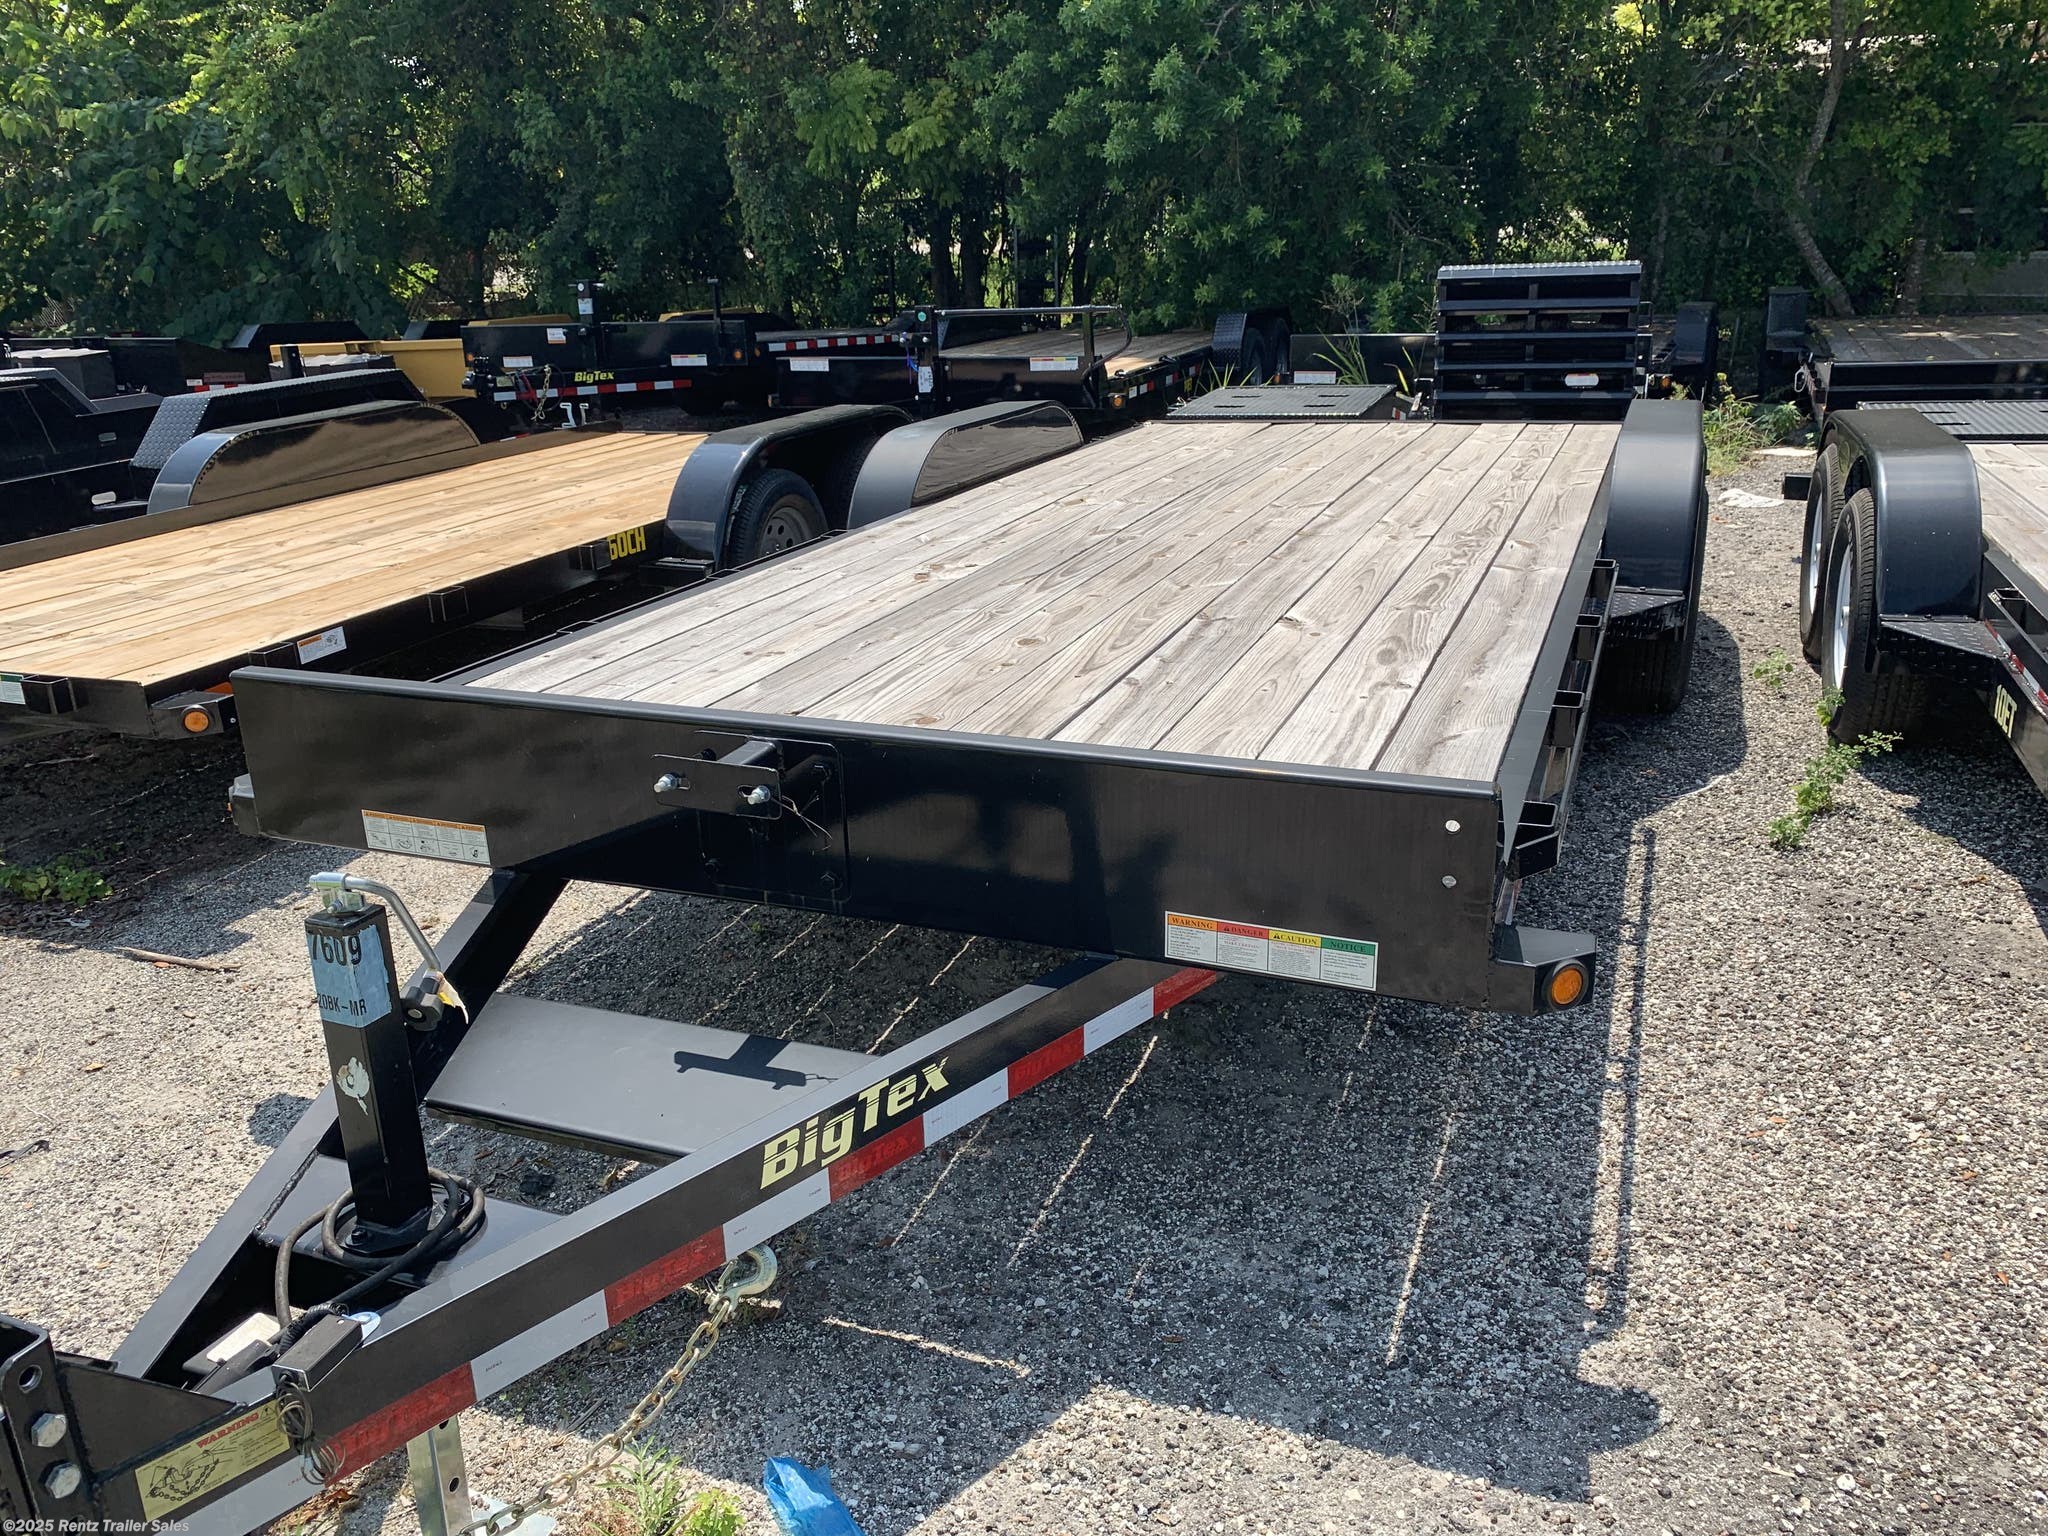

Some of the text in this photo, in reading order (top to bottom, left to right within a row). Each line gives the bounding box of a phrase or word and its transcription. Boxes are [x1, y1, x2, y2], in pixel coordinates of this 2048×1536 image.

[574, 370, 615, 383] BigTex
[1172, 917, 1213, 929] WARNING
[1231, 927, 1264, 937] DANGER
[1280, 933, 1317, 945] CAUTION
[1330, 941, 1367, 953] NOTICE
[760, 1056, 950, 1190] BigTex
[196, 1412, 260, 1449] WARNING
